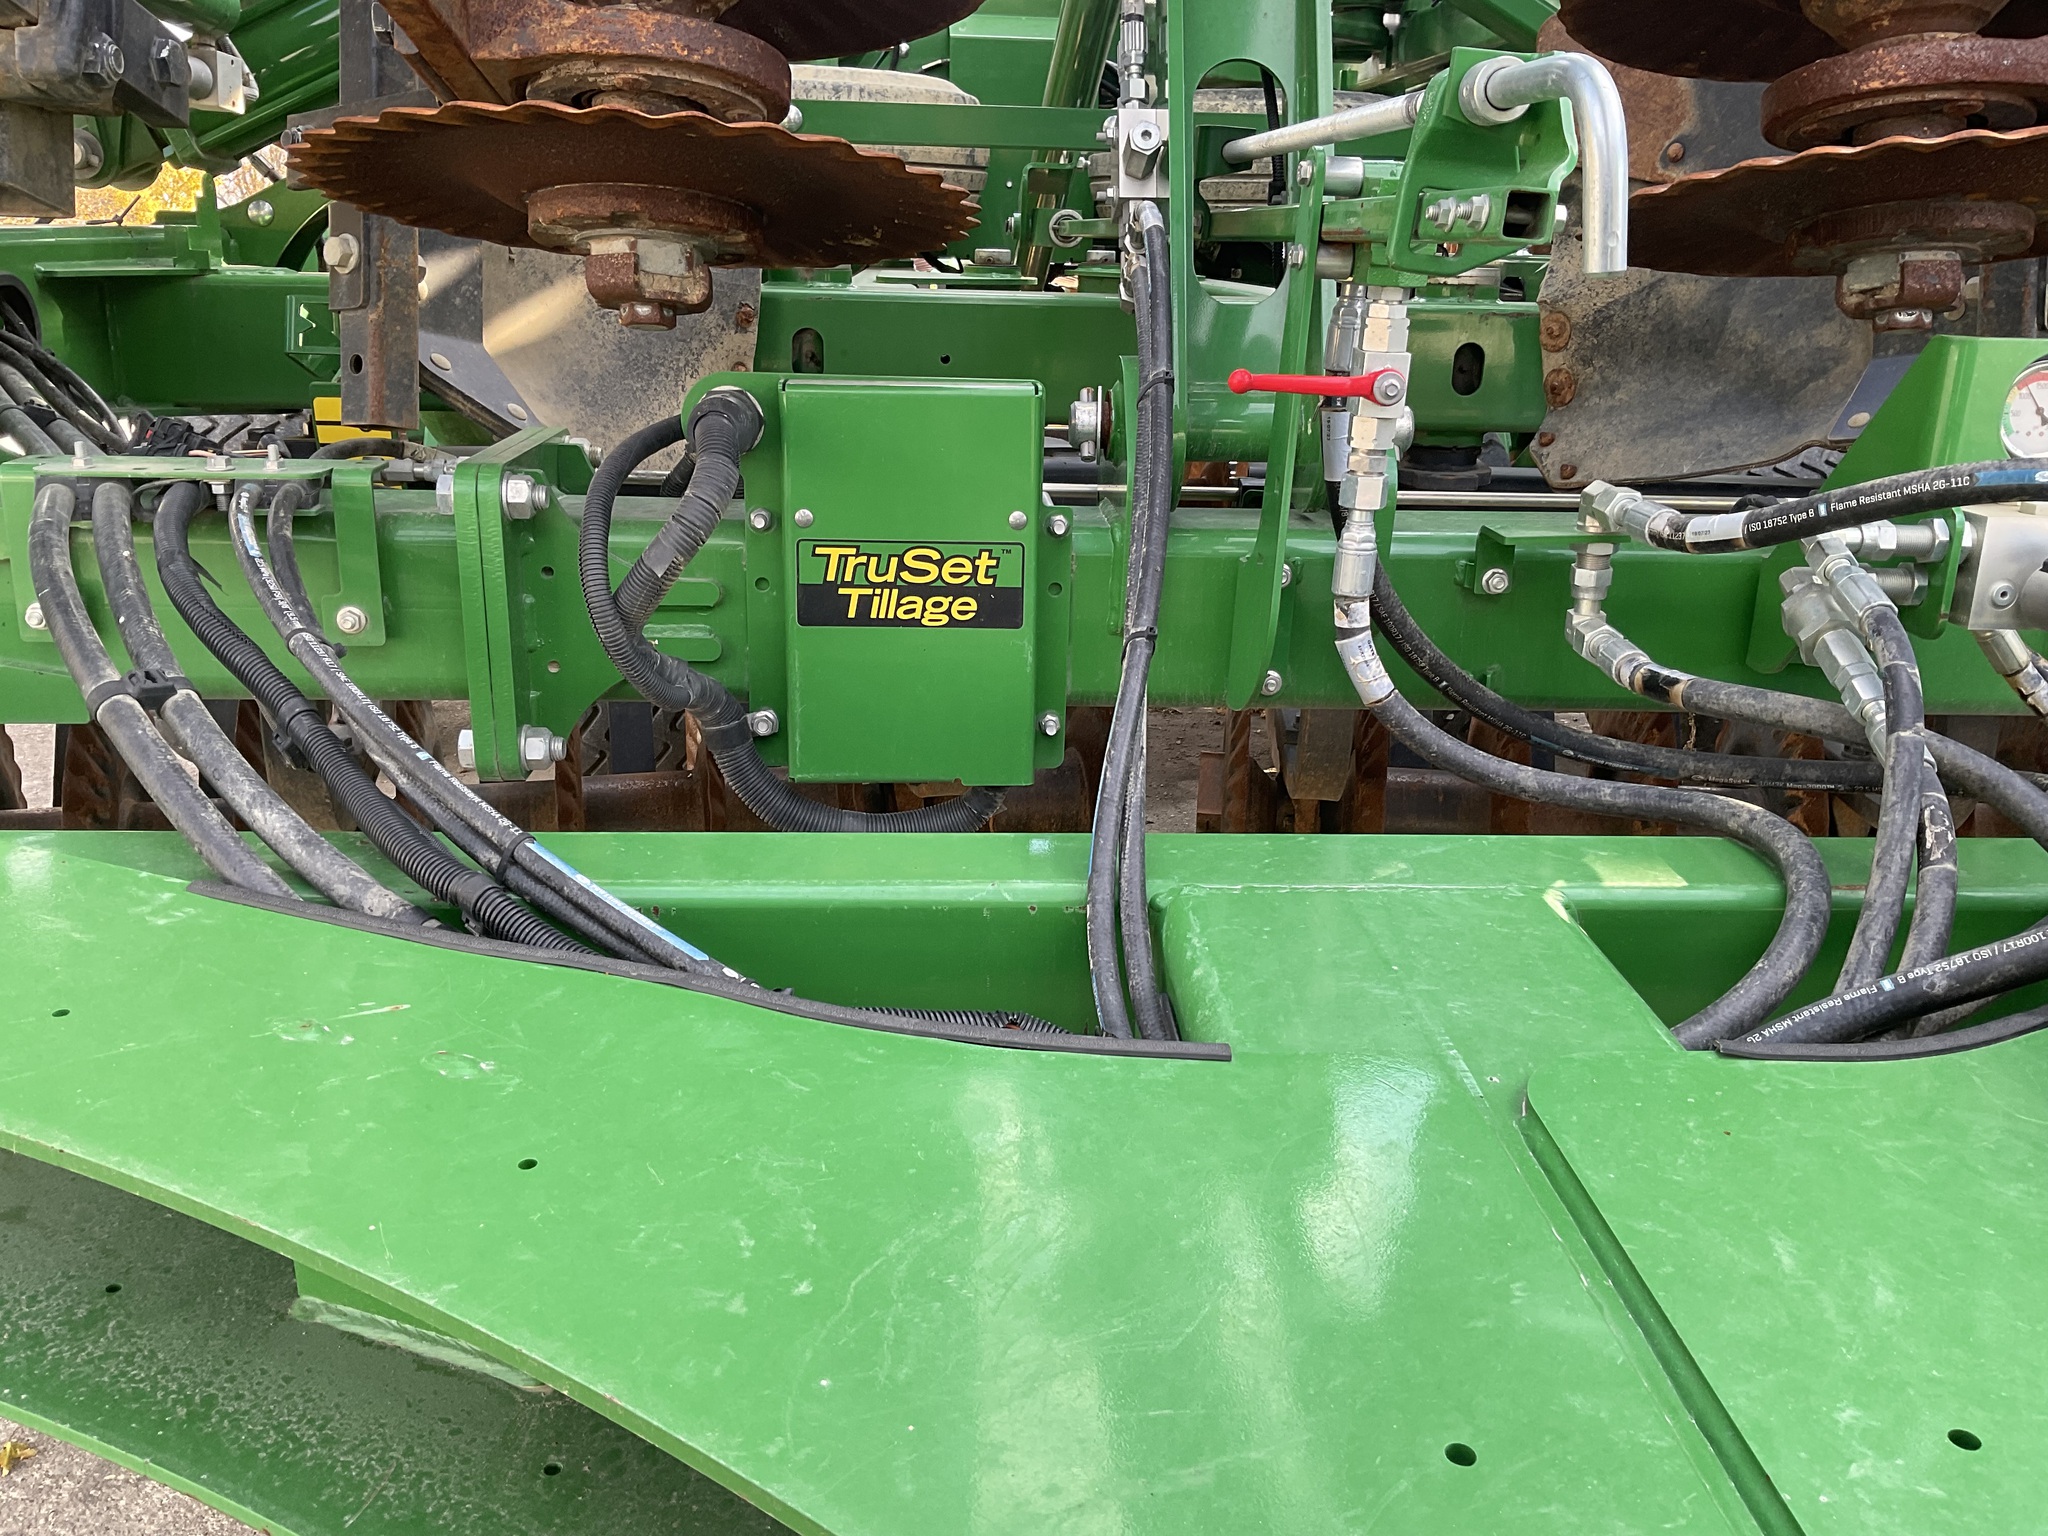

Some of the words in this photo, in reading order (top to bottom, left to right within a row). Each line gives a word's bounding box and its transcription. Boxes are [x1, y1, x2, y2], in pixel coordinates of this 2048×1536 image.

[1748, 521, 1762, 533] ISO
[1762, 515, 1788, 530] 18752
[1789, 510, 1808, 524] Type
[1808, 508, 1815, 518] B
[1830, 497, 1858, 513] Flame
[1859, 488, 1902, 506] Resistant
[1903, 482, 1931, 496] MSHA
[1932, 476, 1971, 490] 2G-11C
[837, 587, 978, 628] Tillage
[429, 760, 452, 778] Flame
[448, 776, 482, 803] Resistant
[2003, 930, 2047, 953] 100R17
[1935, 954, 1972, 973] 18752
[1972, 948, 1993, 961] ISO
[1897, 974, 1907, 984] B
[1907, 966, 1934, 980] Type
[1843, 984, 1879, 1001] Flame
[1794, 997, 1844, 1023] Resistant
[1760, 1018, 1793, 1038] MSHA
